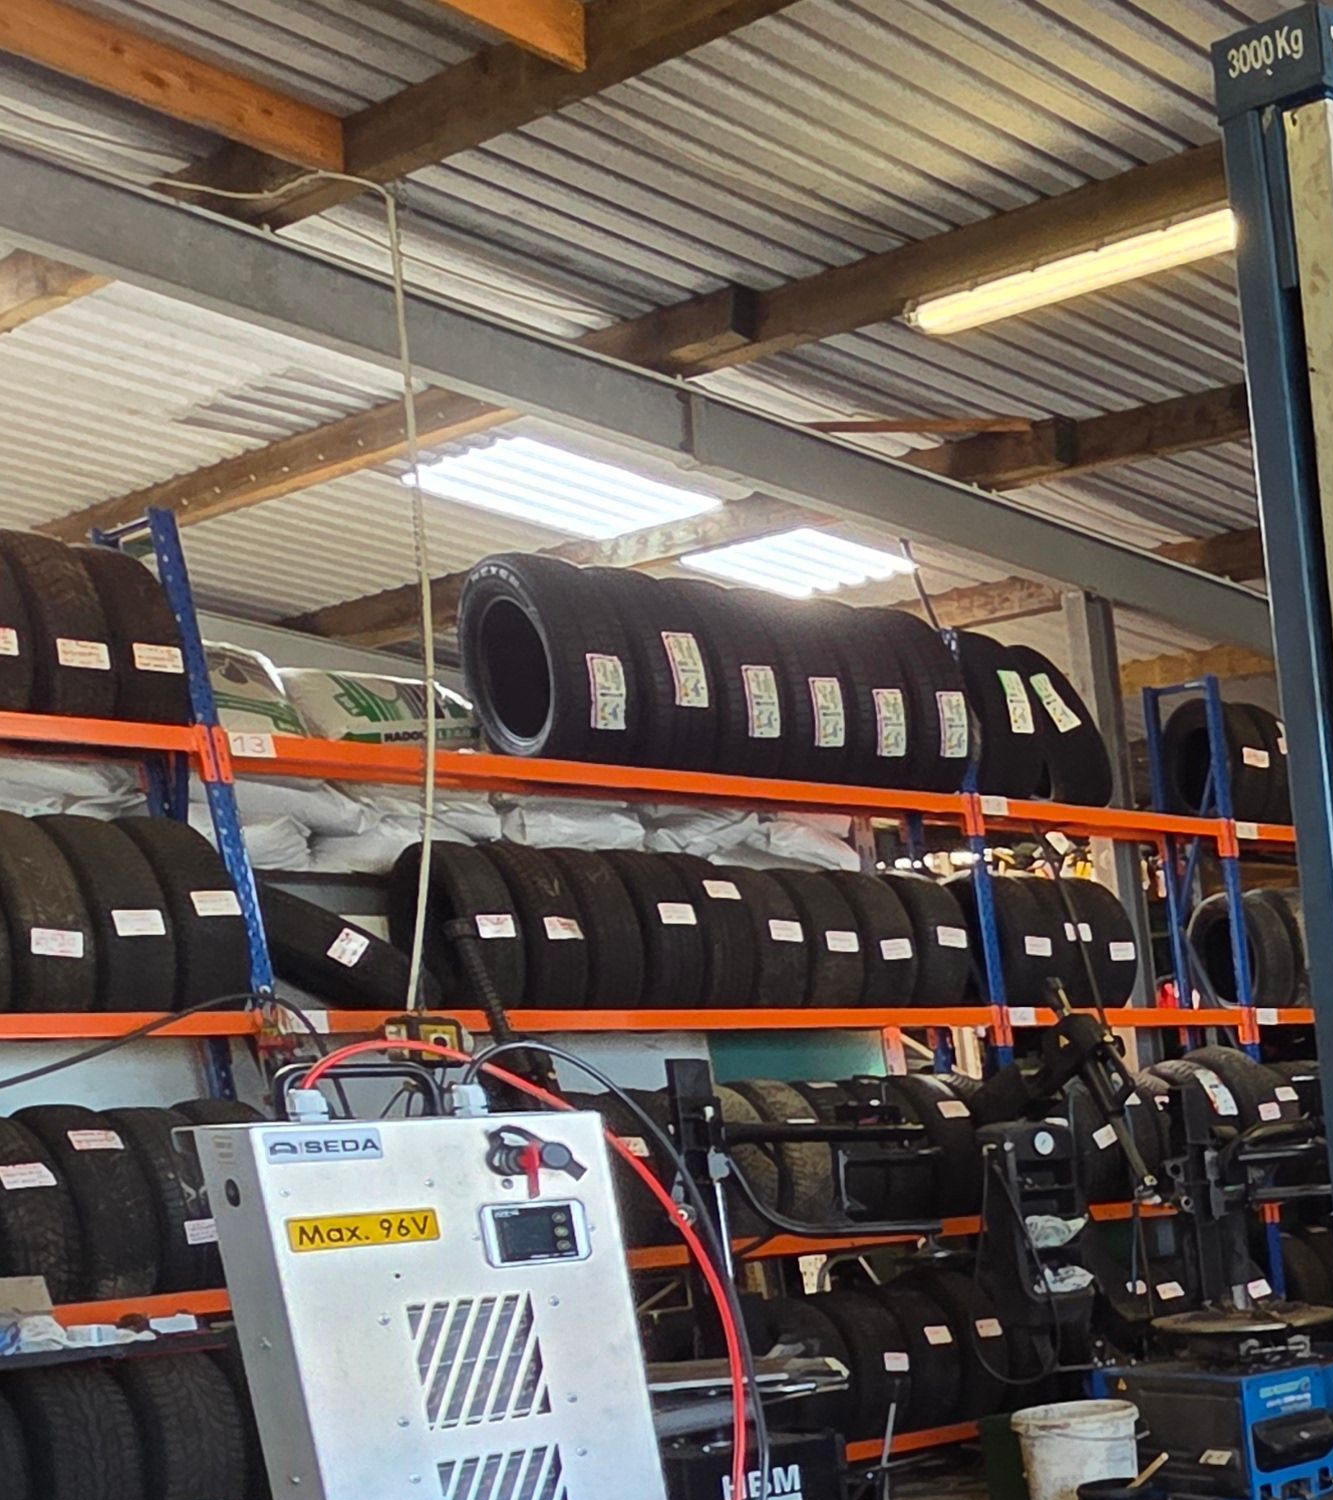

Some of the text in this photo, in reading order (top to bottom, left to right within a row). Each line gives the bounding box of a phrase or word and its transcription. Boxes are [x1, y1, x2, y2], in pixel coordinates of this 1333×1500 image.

[1227, 25, 1304, 79] 3000 Kg
[232, 735, 265, 754] 13
[303, 1138, 381, 1155] SEDA
[299, 1215, 429, 1246] Max. 96V
